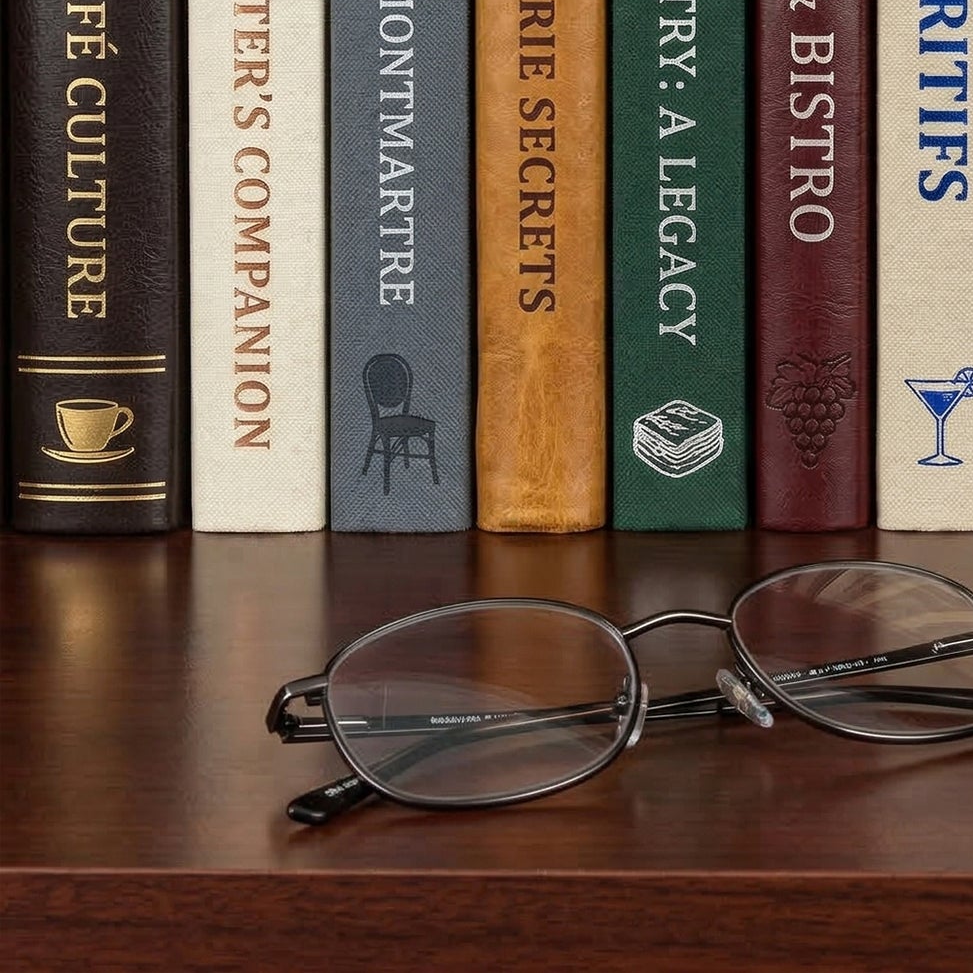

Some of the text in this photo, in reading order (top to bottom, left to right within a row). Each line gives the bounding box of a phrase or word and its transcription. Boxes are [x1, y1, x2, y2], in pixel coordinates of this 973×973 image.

[67, 78, 109, 320] CULTURE
[519, 99, 557, 314] SECRETS
[659, 107, 698, 141] A
[790, 33, 837, 244] BISTRO
[234, 148, 272, 451] COMPANION
[659, 157, 698, 348] LEGACY
